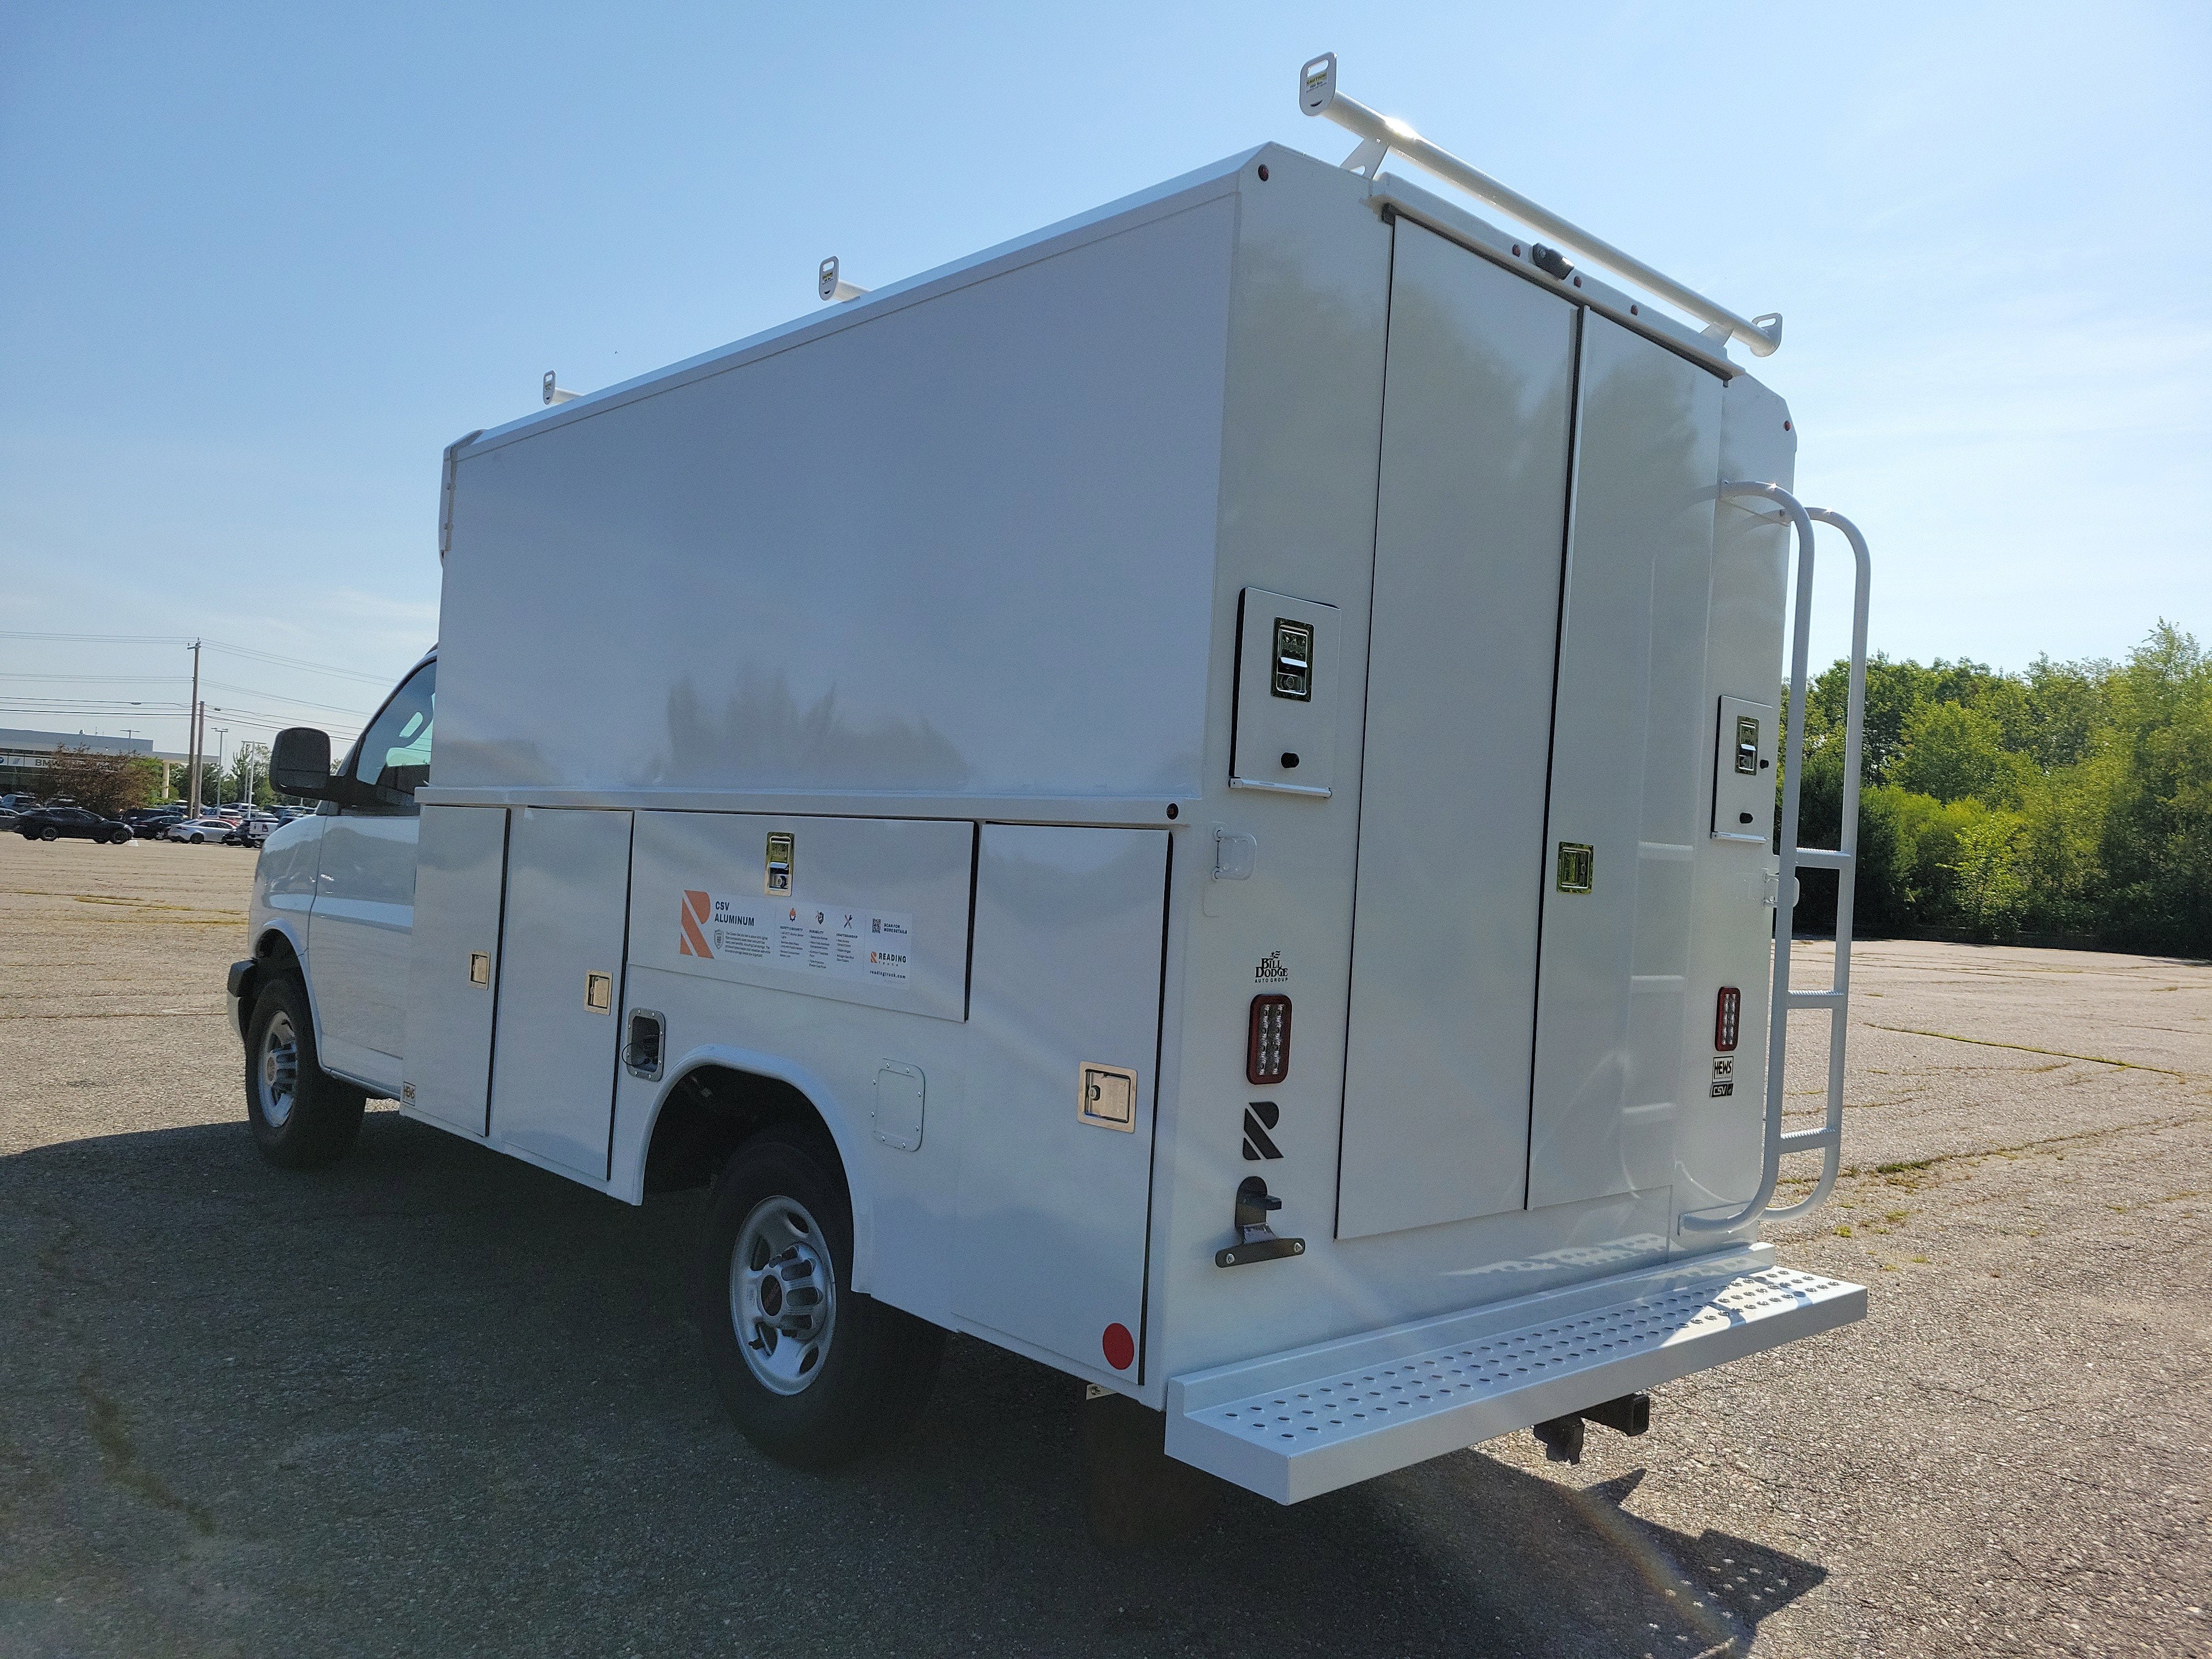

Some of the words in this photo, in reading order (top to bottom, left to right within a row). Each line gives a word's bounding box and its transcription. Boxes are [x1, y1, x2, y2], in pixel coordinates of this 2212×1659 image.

[715, 901, 730, 911] CSV
[715, 913, 754, 926] ALUMINUM
[879, 952, 906, 963] READING
[1261, 958, 1283, 969] BILL
[870, 970, 906, 979] readingtruck.com
[1255, 967, 1288, 978] DODGE
[1713, 1086, 1726, 1096] CSV
